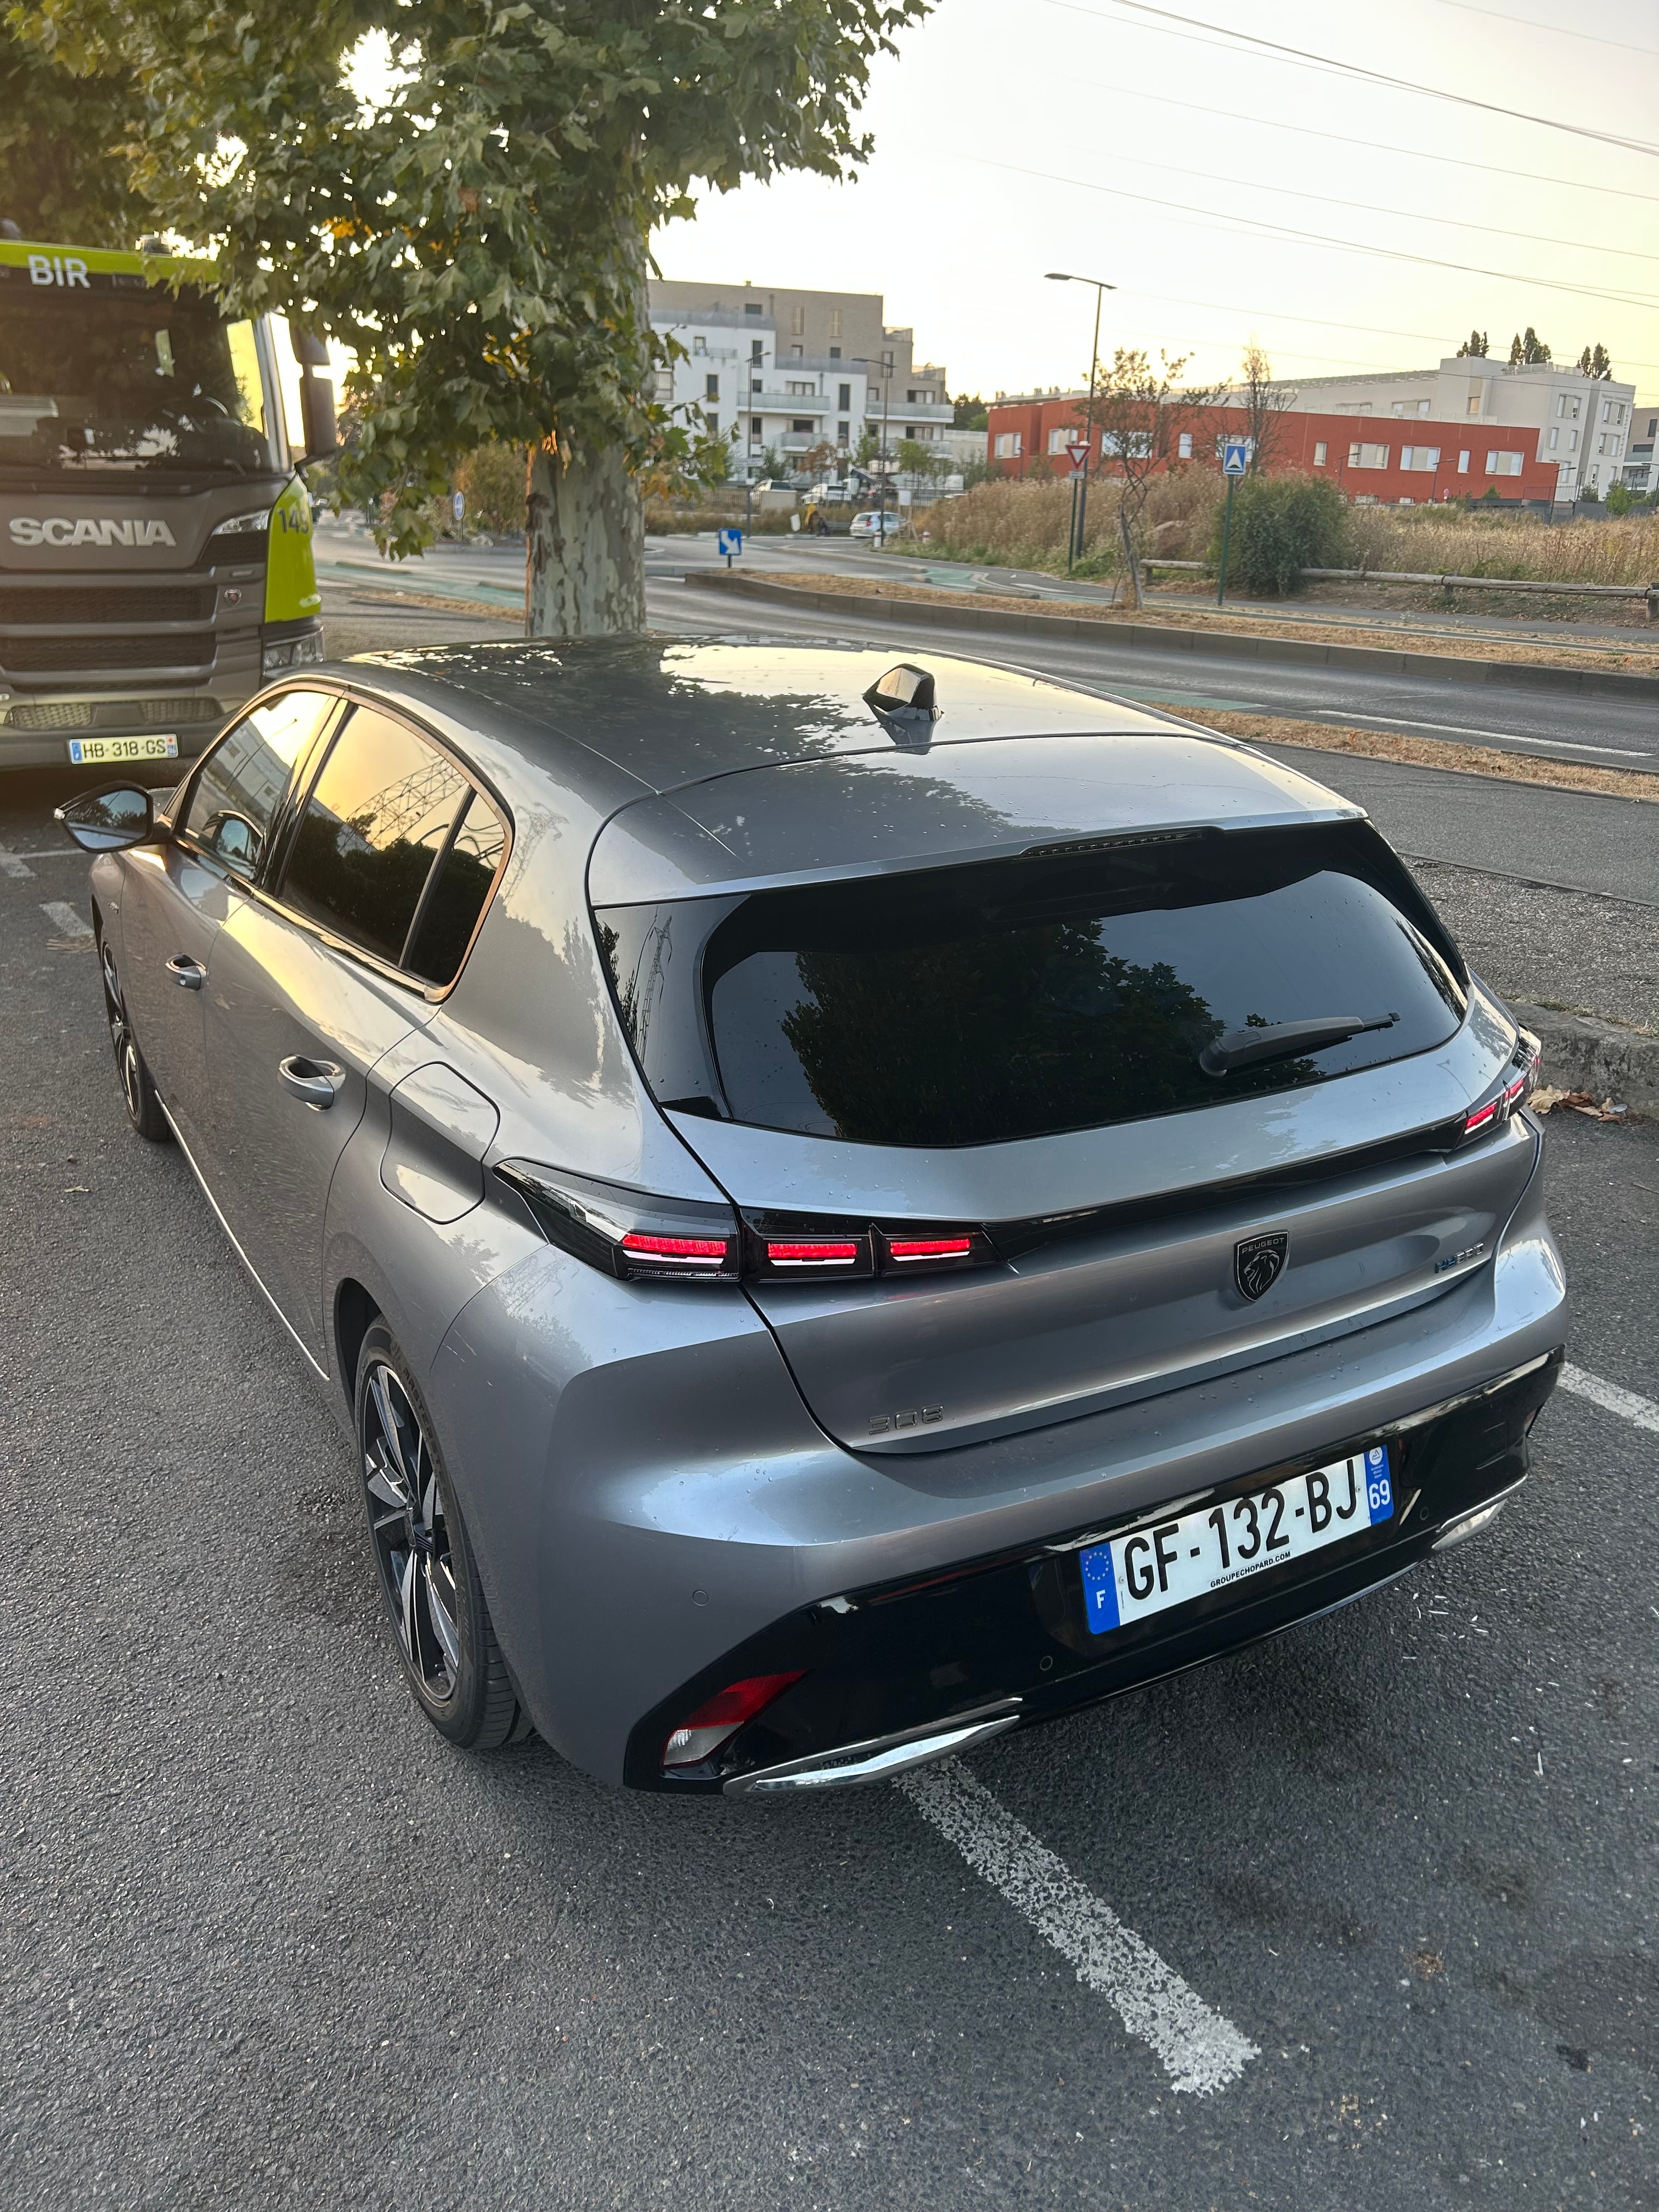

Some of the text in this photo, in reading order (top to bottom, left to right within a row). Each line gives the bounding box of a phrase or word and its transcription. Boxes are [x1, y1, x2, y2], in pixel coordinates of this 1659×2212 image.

[28, 254, 91, 289] BIR
[9, 517, 177, 546] SCANIA
[83, 739, 166, 758] HB-318-GS
[1242, 1237, 1284, 1254] PEUGEOT
[869, 1404, 944, 1435] 308
[1369, 1479, 1390, 1509] 69
[1125, 1459, 1357, 1600] GF-132-BJ
[1210, 1551, 1291, 1588] GROUPECHOPARD.COM
[1096, 1590, 1105, 1609] F
